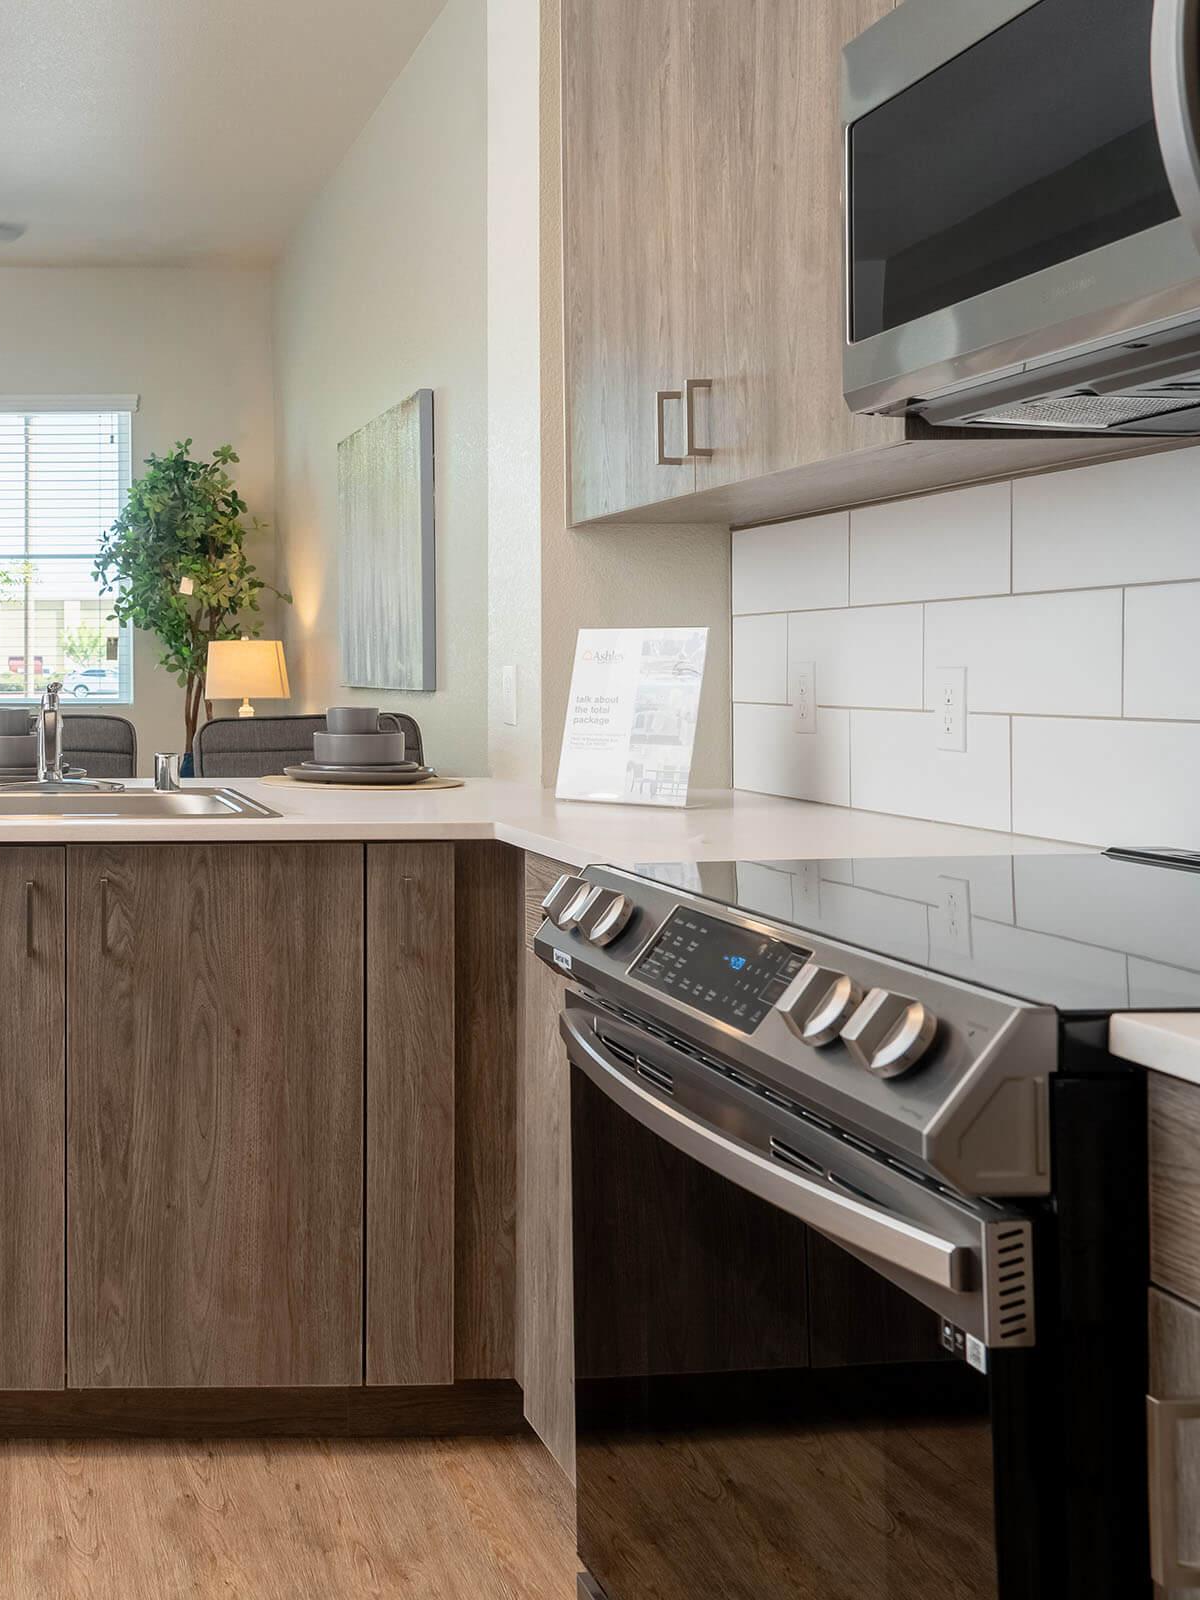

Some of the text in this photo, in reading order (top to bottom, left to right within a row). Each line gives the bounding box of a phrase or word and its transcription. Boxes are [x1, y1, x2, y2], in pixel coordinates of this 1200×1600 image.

[576, 695, 619, 704] talk about
[575, 705, 610, 713] the total
[573, 716, 610, 726] package
